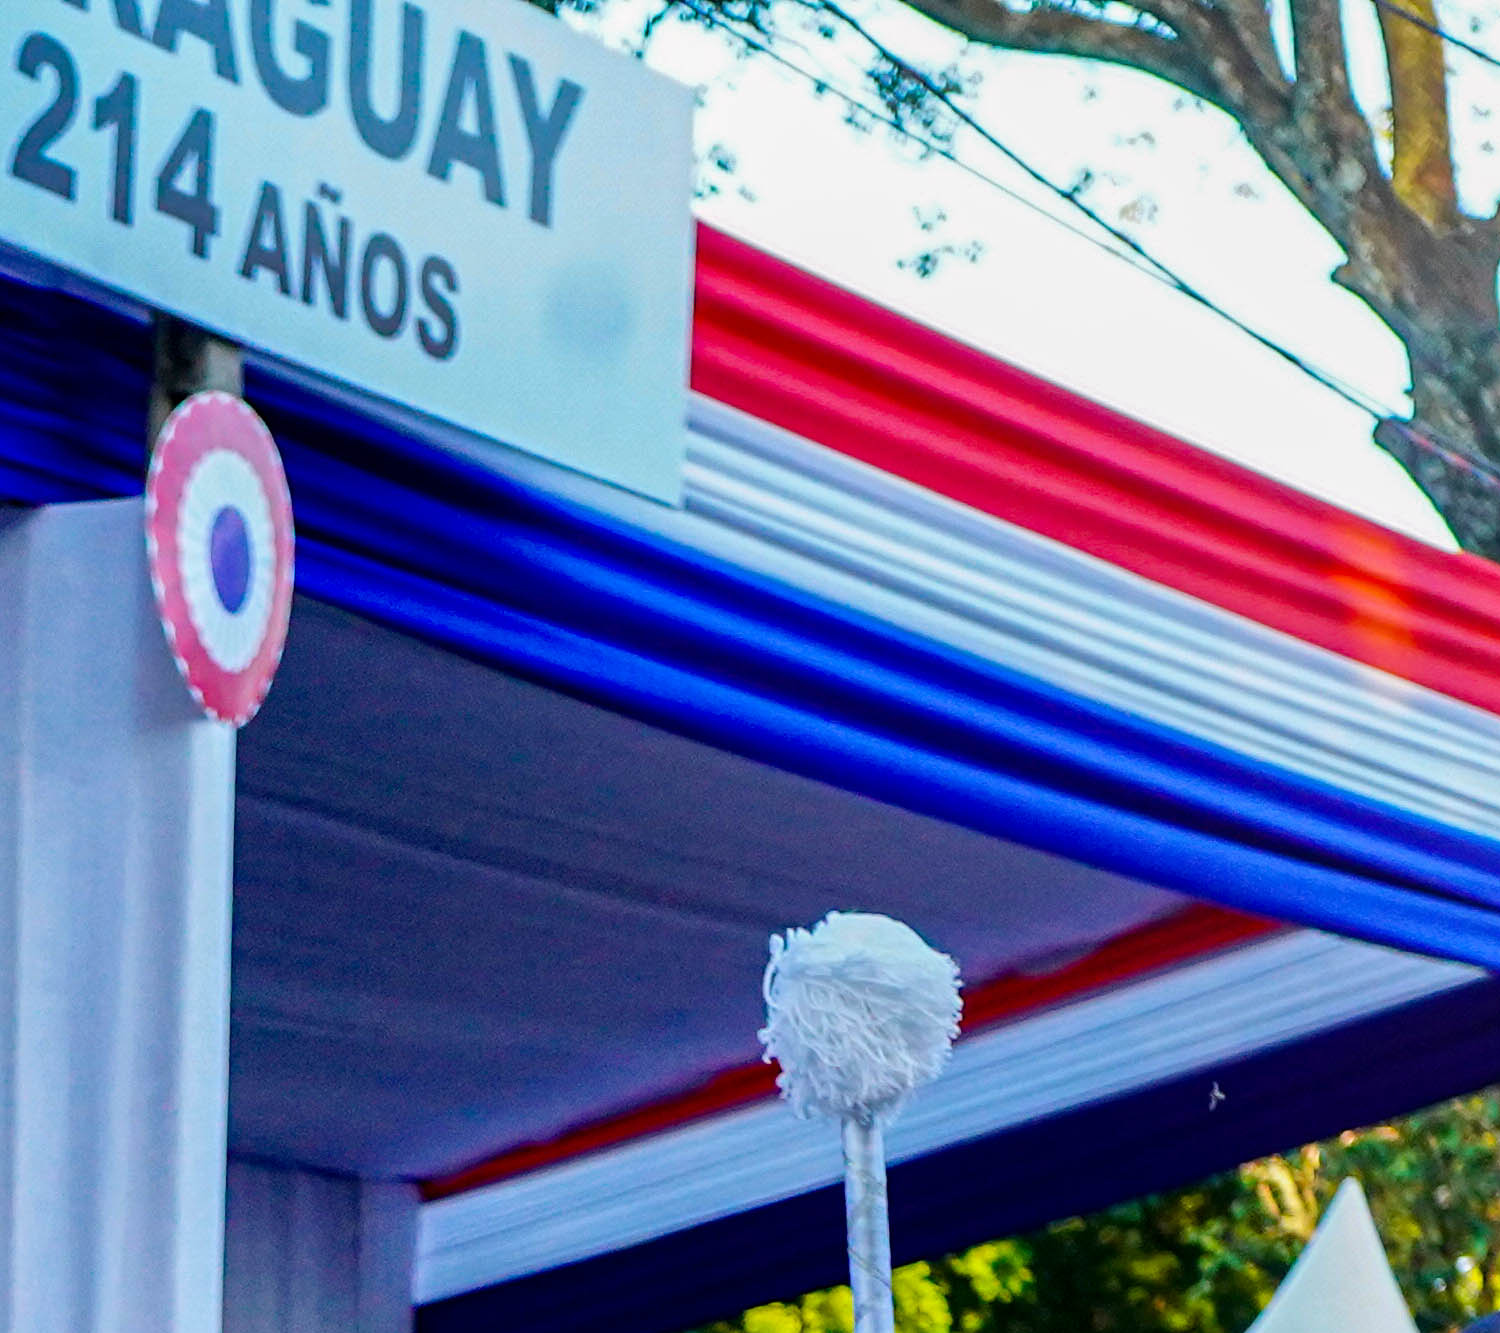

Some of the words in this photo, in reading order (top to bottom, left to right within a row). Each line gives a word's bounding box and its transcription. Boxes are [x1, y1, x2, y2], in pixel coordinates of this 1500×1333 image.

[7, 31, 220, 260] 214
[236, 181, 460, 362] AÑOS
[62, 0, 583, 228] AGUAY
